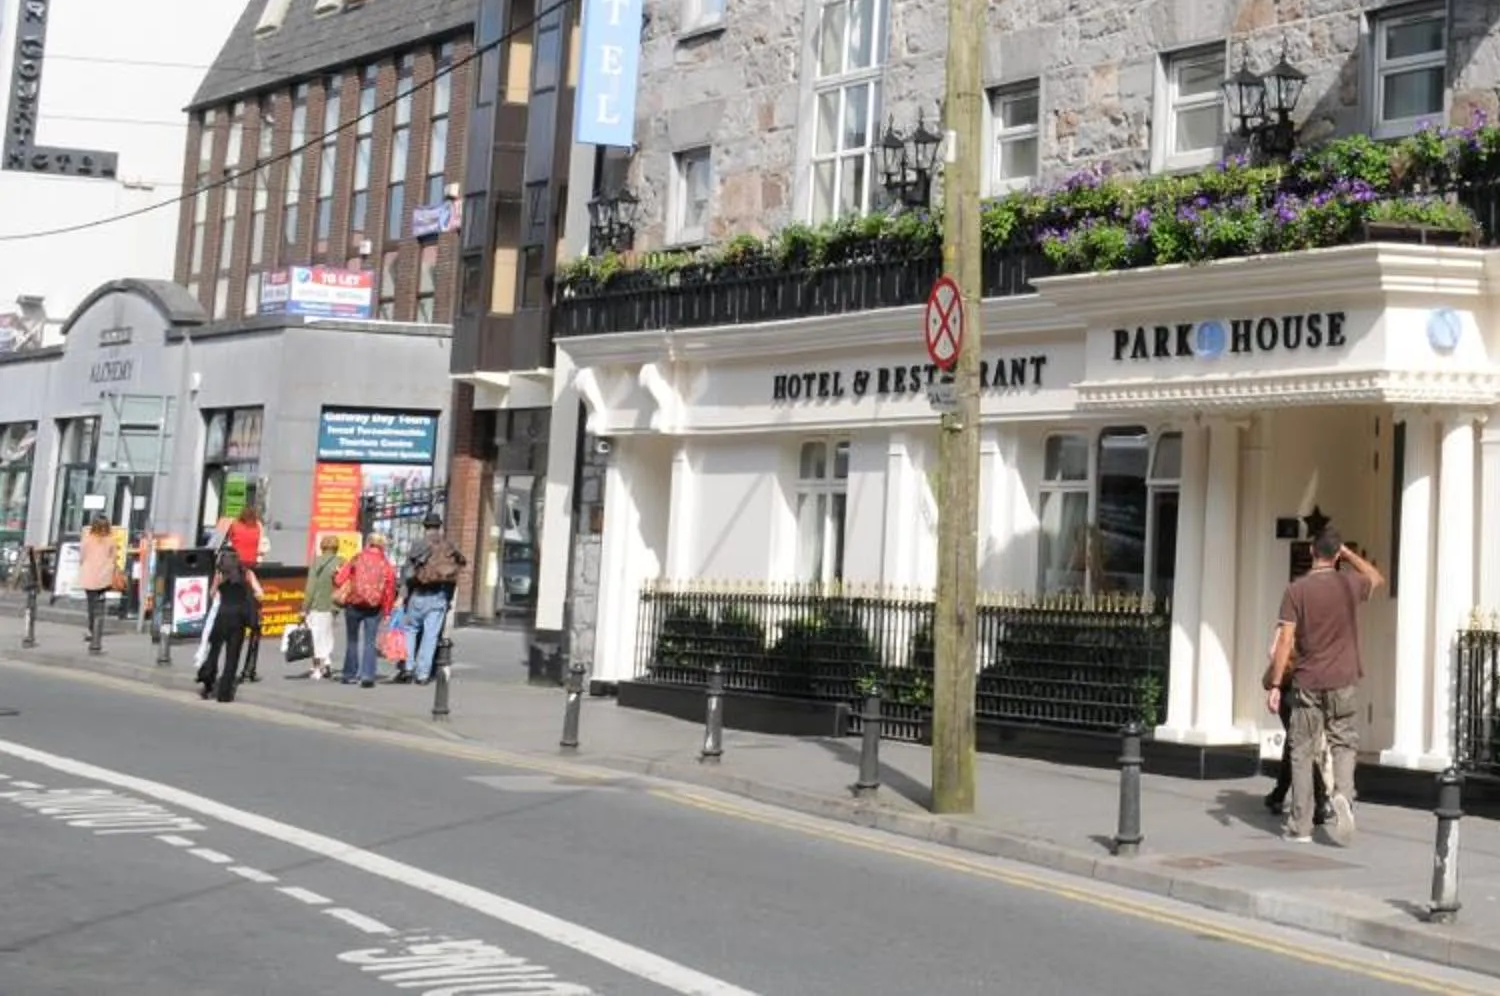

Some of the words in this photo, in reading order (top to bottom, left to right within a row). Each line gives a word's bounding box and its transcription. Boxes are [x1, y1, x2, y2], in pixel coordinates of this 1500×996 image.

[1112, 323, 1194, 361] PARK
[1229, 312, 1346, 354] HOUSE
[773, 371, 844, 400] HOTEL
[853, 370, 870, 395] &
[877, 355, 1047, 393] RESTRANT
